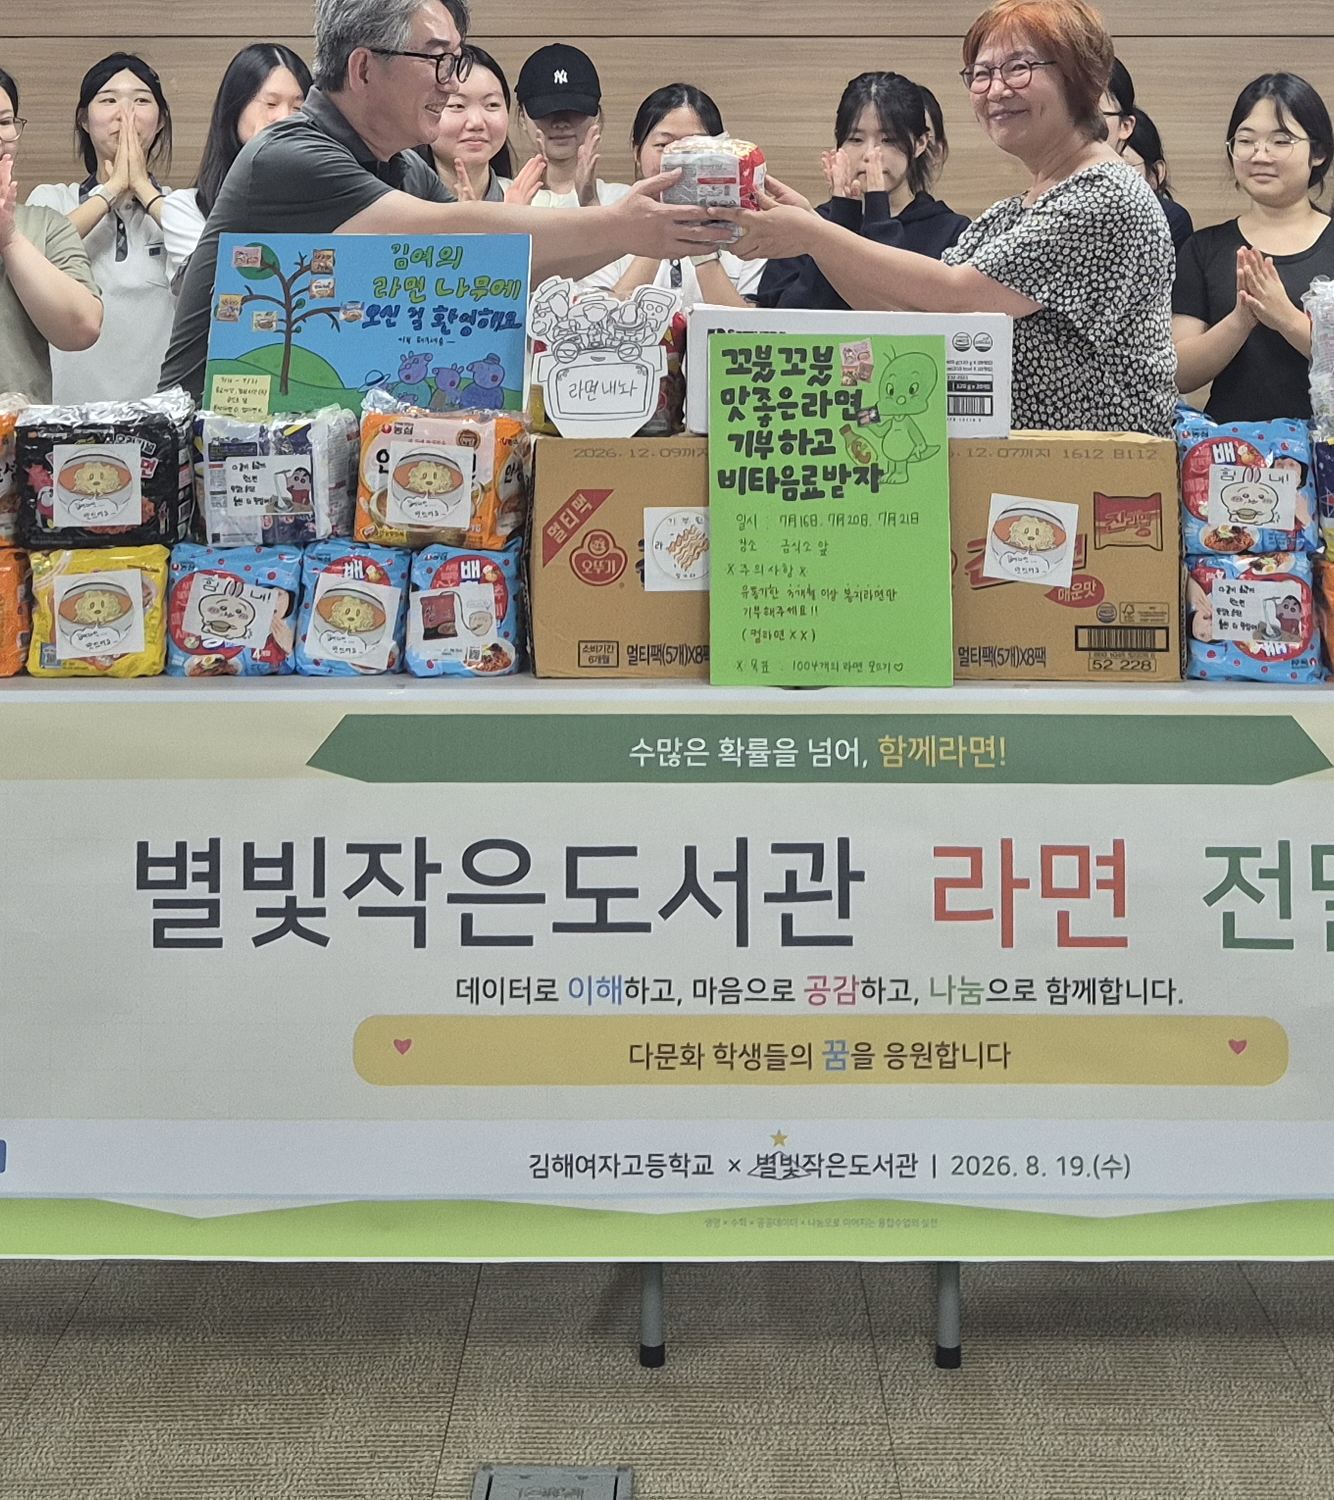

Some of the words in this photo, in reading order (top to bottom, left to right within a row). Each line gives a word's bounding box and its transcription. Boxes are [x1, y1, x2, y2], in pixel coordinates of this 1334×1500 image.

[391, 243, 463, 270] 김여의
[372, 278, 425, 303] 라면
[436, 276, 521, 301] 나무에
[431, 306, 522, 337] 환영해요
[1220, 467, 1237, 481] 힘
[546, 492, 593, 545] 멀티팩
[780, 538, 812, 553] 급식소
[581, 560, 617, 575] 오뚜기
[741, 583, 779, 600] 유통기한
[1092, 659, 1113, 671] 52
[1120, 660, 1152, 671] 228
[628, 736, 710, 768] 수많은
[718, 736, 799, 768] 확률을
[807, 737, 869, 770] 넘어,
[877, 734, 1007, 770] 함께라면!
[135, 835, 866, 950] 별빛작은도서관
[932, 837, 1129, 950] 라면
[456, 975, 560, 1006] 데이터로
[567, 974, 683, 1007] 이해하고,
[692, 976, 796, 1006] 마음으로
[803, 974, 920, 1007] 공감하고,
[929, 974, 1038, 1006] 나눔으로
[1045, 975, 1185, 1007] 함께합니다.
[628, 1041, 706, 1072] 다문화
[712, 1041, 814, 1072] 학생들의
[822, 1039, 875, 1072] 꿈을
[883, 1041, 1012, 1071] 응원합니다
[528, 1152, 714, 1180] 김해여자고등학교
[755, 1152, 919, 1180] 별빛작은도서관
[951, 1154, 1018, 1178] 2026.
[1025, 1154, 1047, 1178] 8.
[1055, 1153, 1131, 1181] 19.(수)
